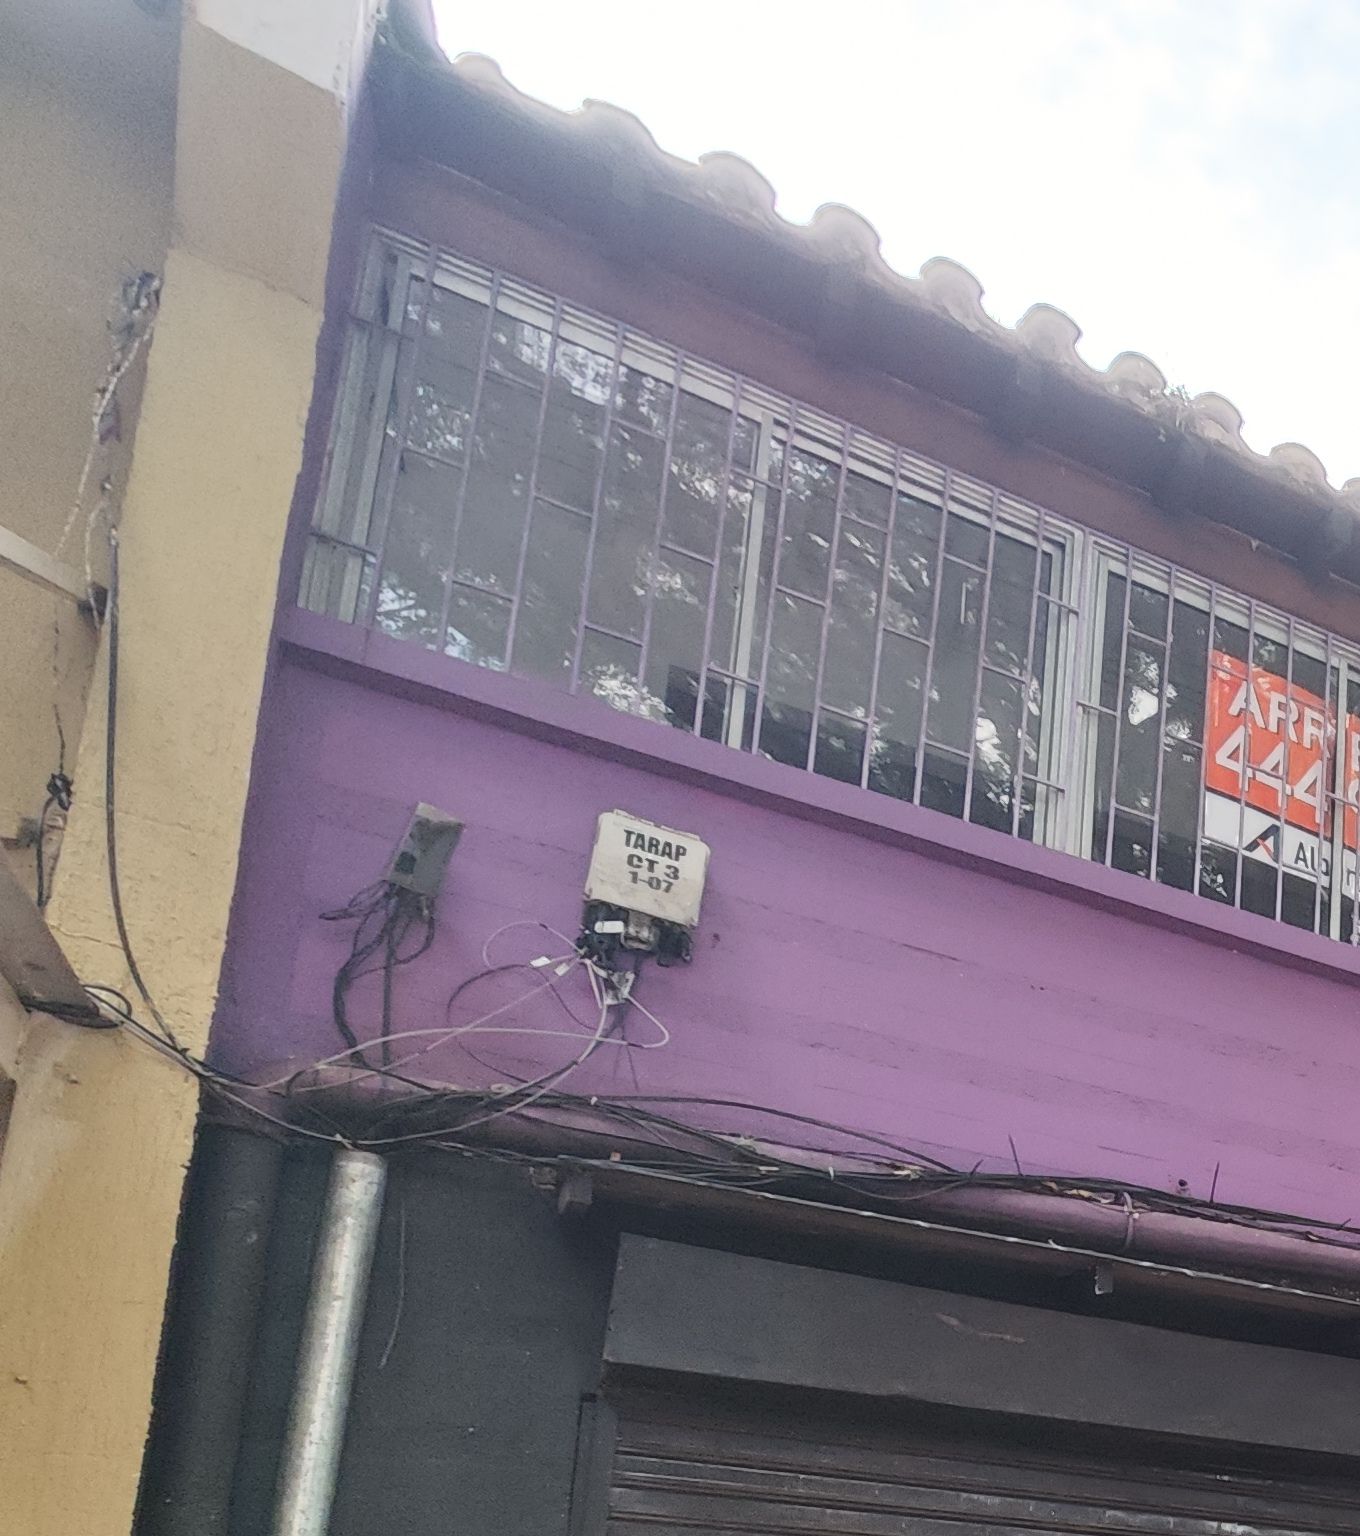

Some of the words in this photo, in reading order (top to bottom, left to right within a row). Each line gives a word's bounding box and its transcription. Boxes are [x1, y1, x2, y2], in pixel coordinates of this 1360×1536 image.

[1215, 724, 1331, 825] 444
[624, 829, 687, 861] TARAP
[626, 853, 660, 874] CT
[664, 864, 681, 881] 3
[628, 870, 674, 893] 1-07
